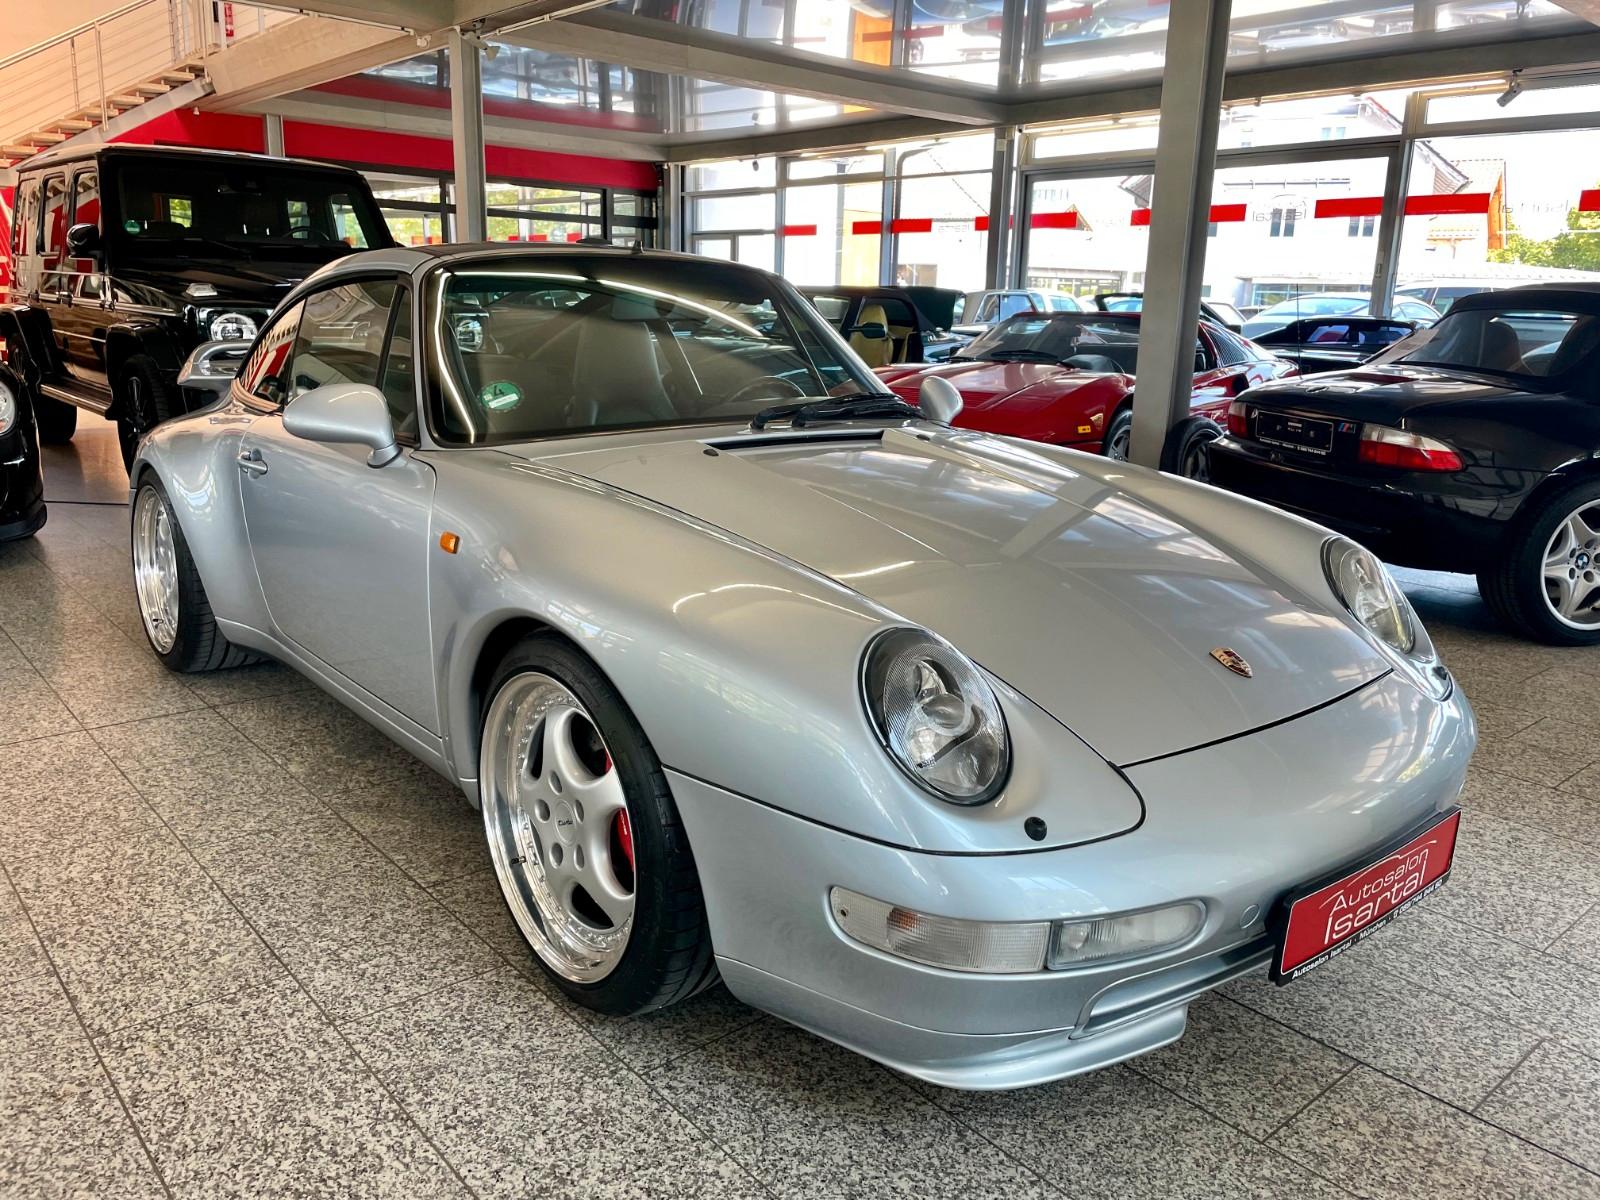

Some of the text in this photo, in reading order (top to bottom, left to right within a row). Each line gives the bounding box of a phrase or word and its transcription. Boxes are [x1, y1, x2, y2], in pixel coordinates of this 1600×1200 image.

[1324, 863, 1426, 944] Isartal
[1330, 849, 1429, 916] Autosalon
[1292, 954, 1329, 980] Autosalon
[1330, 939, 1352, 957] Isartal
